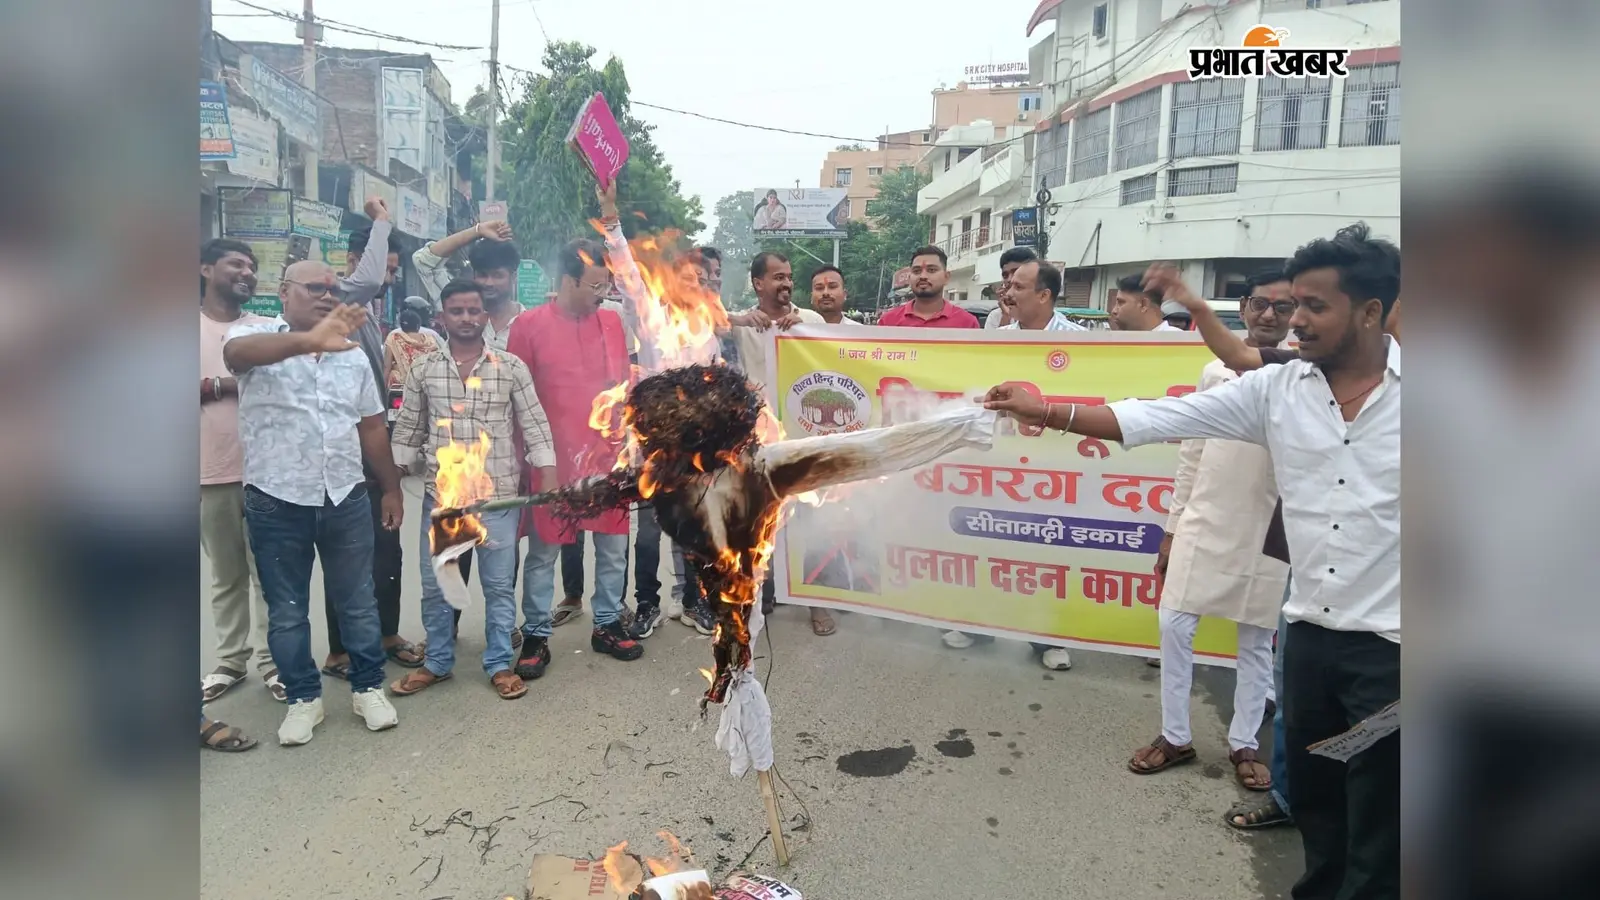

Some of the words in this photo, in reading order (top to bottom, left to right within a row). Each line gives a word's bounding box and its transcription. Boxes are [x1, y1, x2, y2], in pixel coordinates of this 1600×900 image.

[997, 62, 1028, 73] HOSPITAL
[848, 350, 867, 360] जय
[871, 348, 883, 360] श्री
[887, 351, 906, 361] राम
[813, 372, 834, 387] हिन्दू
[837, 376, 866, 401] परिषद
[913, 456, 1083, 504] बजरंग
[966, 511, 1065, 544] सीतामढ़ी
[1069, 525, 1146, 549] इकाई
[988, 557, 1071, 599] दहन
